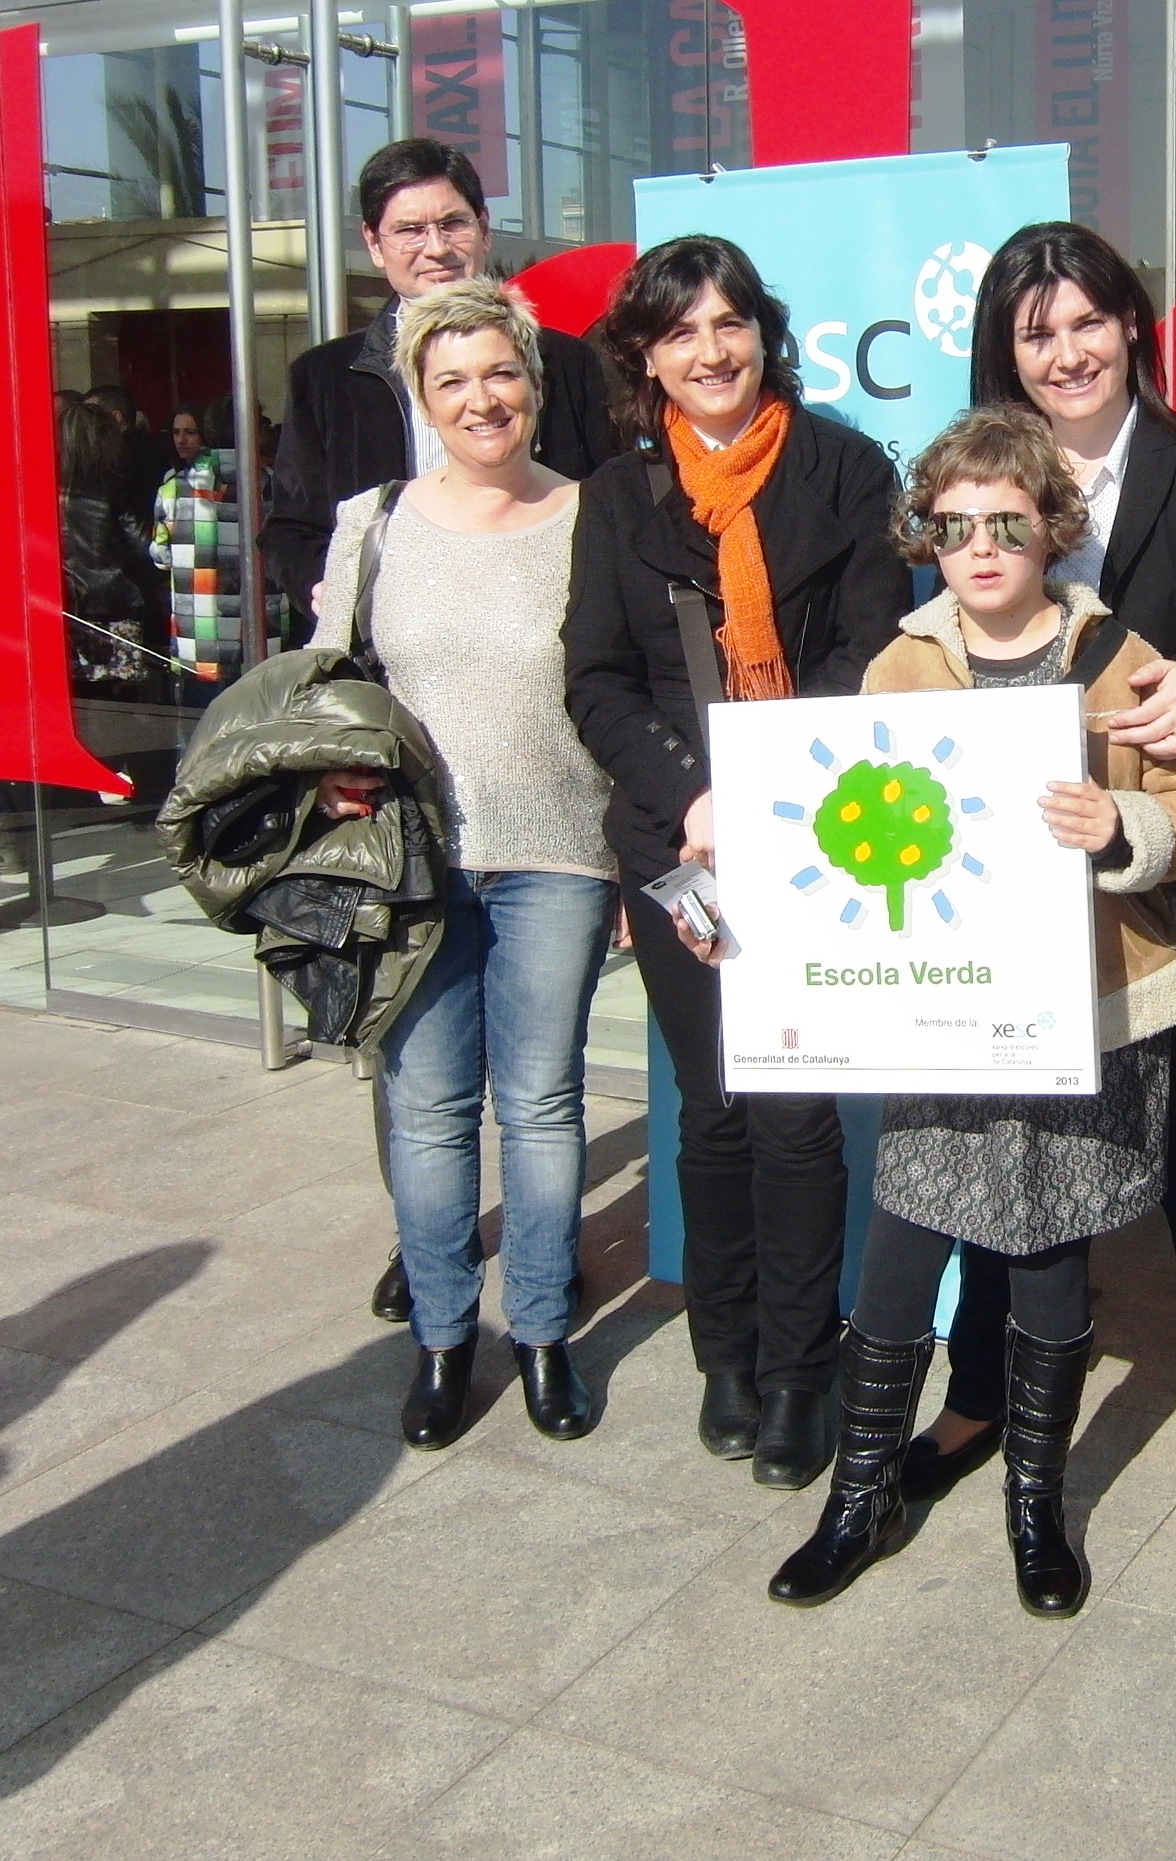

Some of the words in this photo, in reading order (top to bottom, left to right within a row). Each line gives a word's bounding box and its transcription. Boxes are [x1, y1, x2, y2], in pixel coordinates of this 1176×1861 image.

[806, 962, 899, 986] Escola
[909, 961, 992, 985] Verda
[915, 1018, 952, 1028] Membre
[955, 1018, 967, 1028] de
[969, 1018, 980, 1028] la:
[992, 1023, 1037, 1038] xesc
[733, 1054, 785, 1064] Generalitat
[788, 1054, 800, 1064] de
[802, 1054, 850, 1066] Catalunya
[1055, 1076, 1079, 1086] 2013
